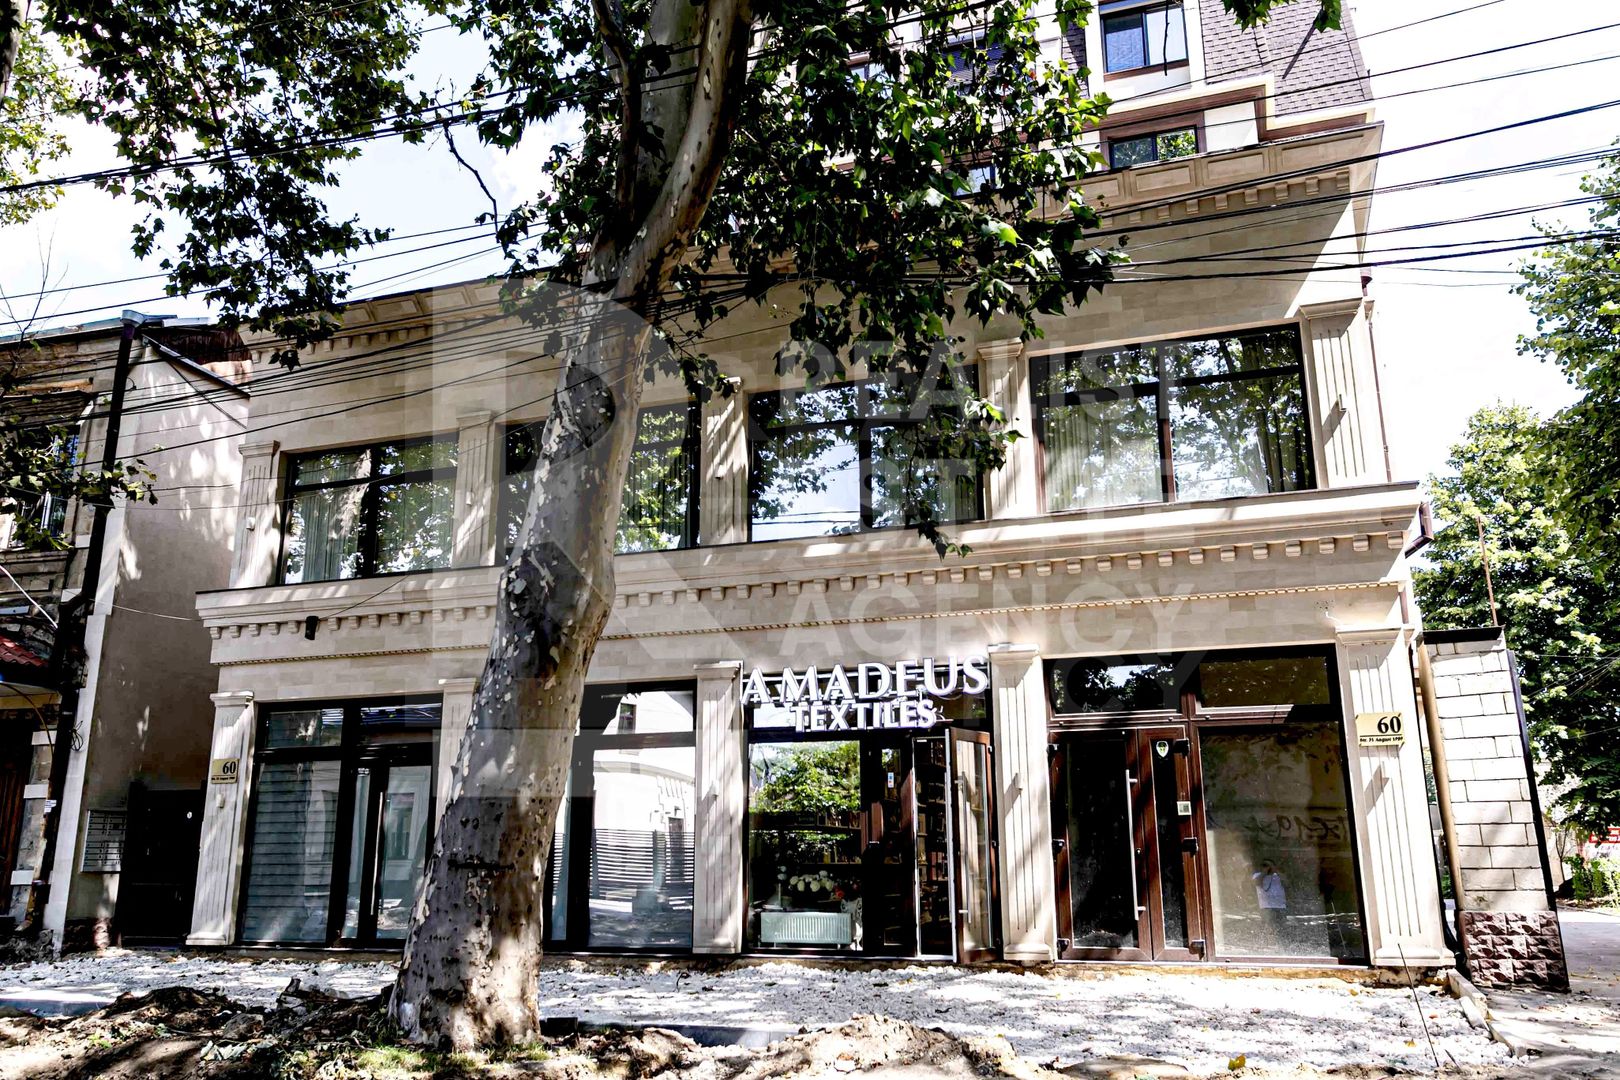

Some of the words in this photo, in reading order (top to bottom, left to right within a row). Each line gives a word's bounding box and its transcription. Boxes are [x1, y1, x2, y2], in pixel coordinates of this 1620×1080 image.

[743, 656, 989, 704] AMADEUS
[793, 699, 937, 733] TEXTILES
[1377, 715, 1402, 734] 60
[222, 761, 237, 774] 60
